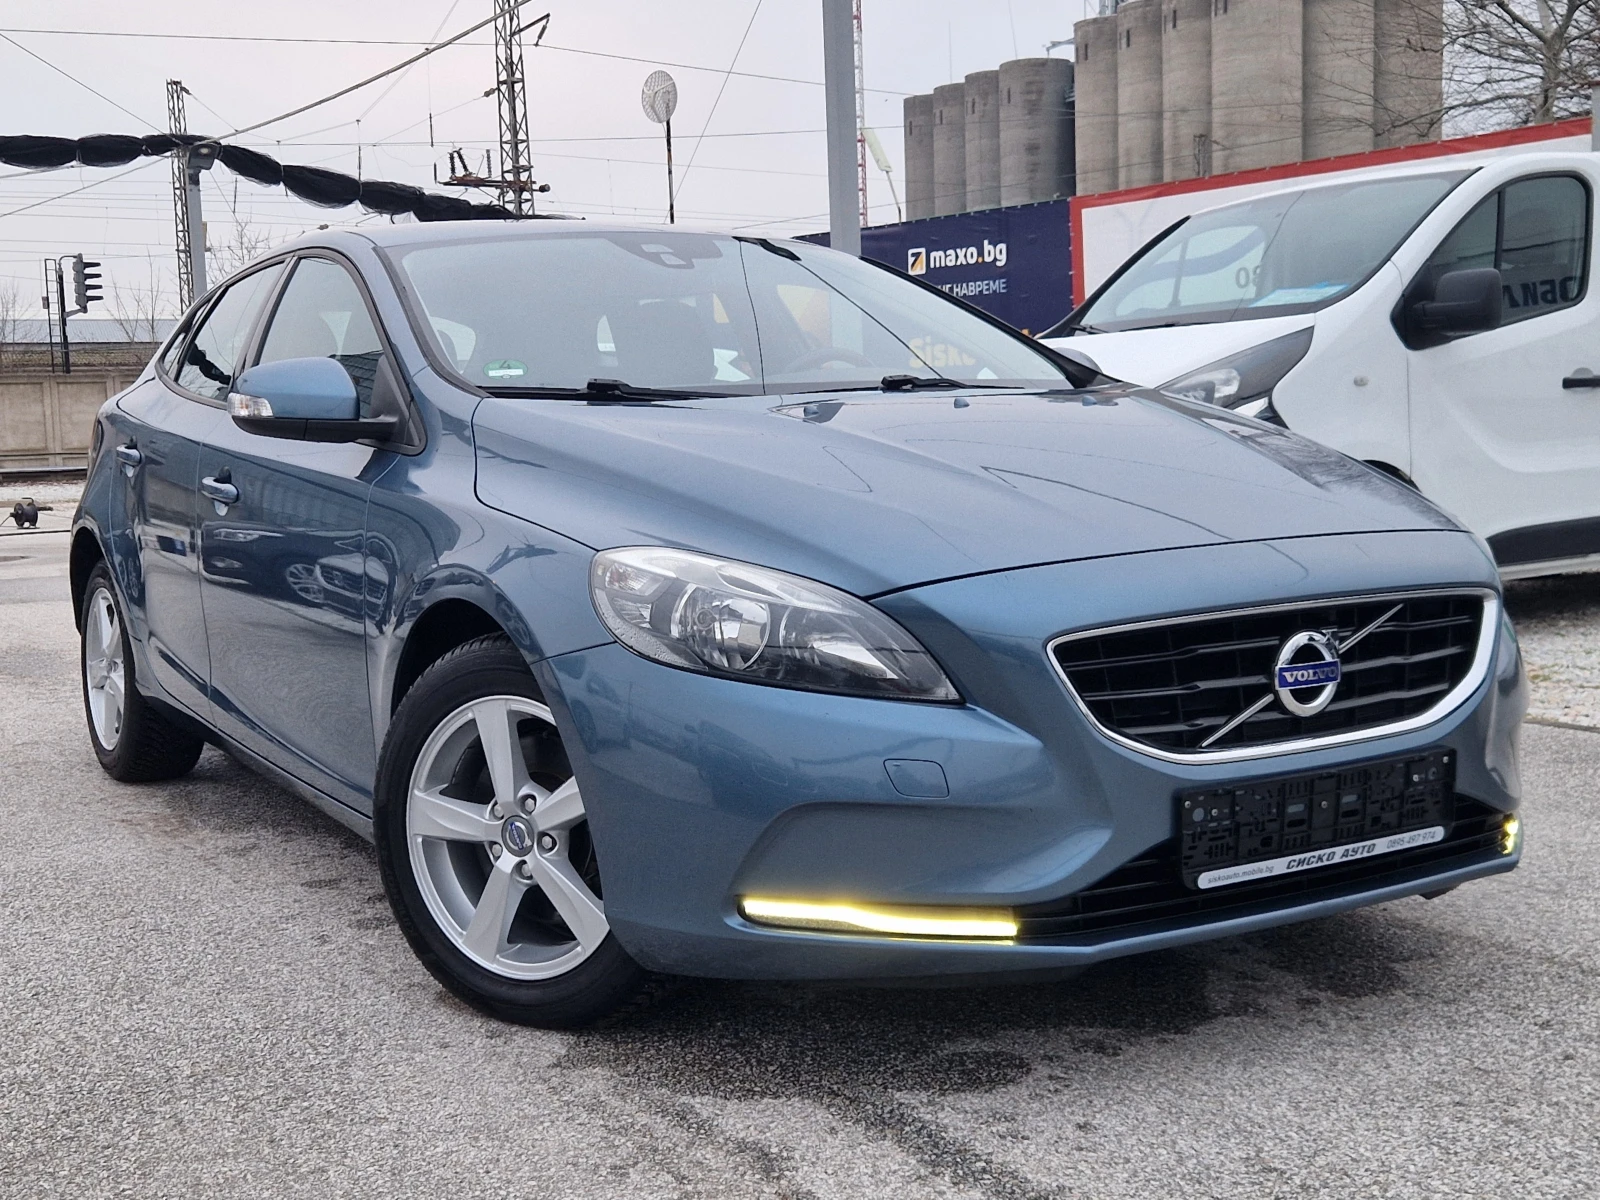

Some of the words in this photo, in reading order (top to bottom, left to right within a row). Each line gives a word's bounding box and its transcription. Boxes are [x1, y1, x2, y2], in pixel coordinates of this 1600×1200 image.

[930, 239, 1007, 269] maxo.bg
[953, 279, 1008, 297] НАВРЕМЕ
[1282, 666, 1337, 683] VOLVO
[1207, 865, 1275, 884] siskoauto.mobile.bg
[1286, 851, 1336, 870] СИСКО
[1340, 843, 1376, 859] АУТО
